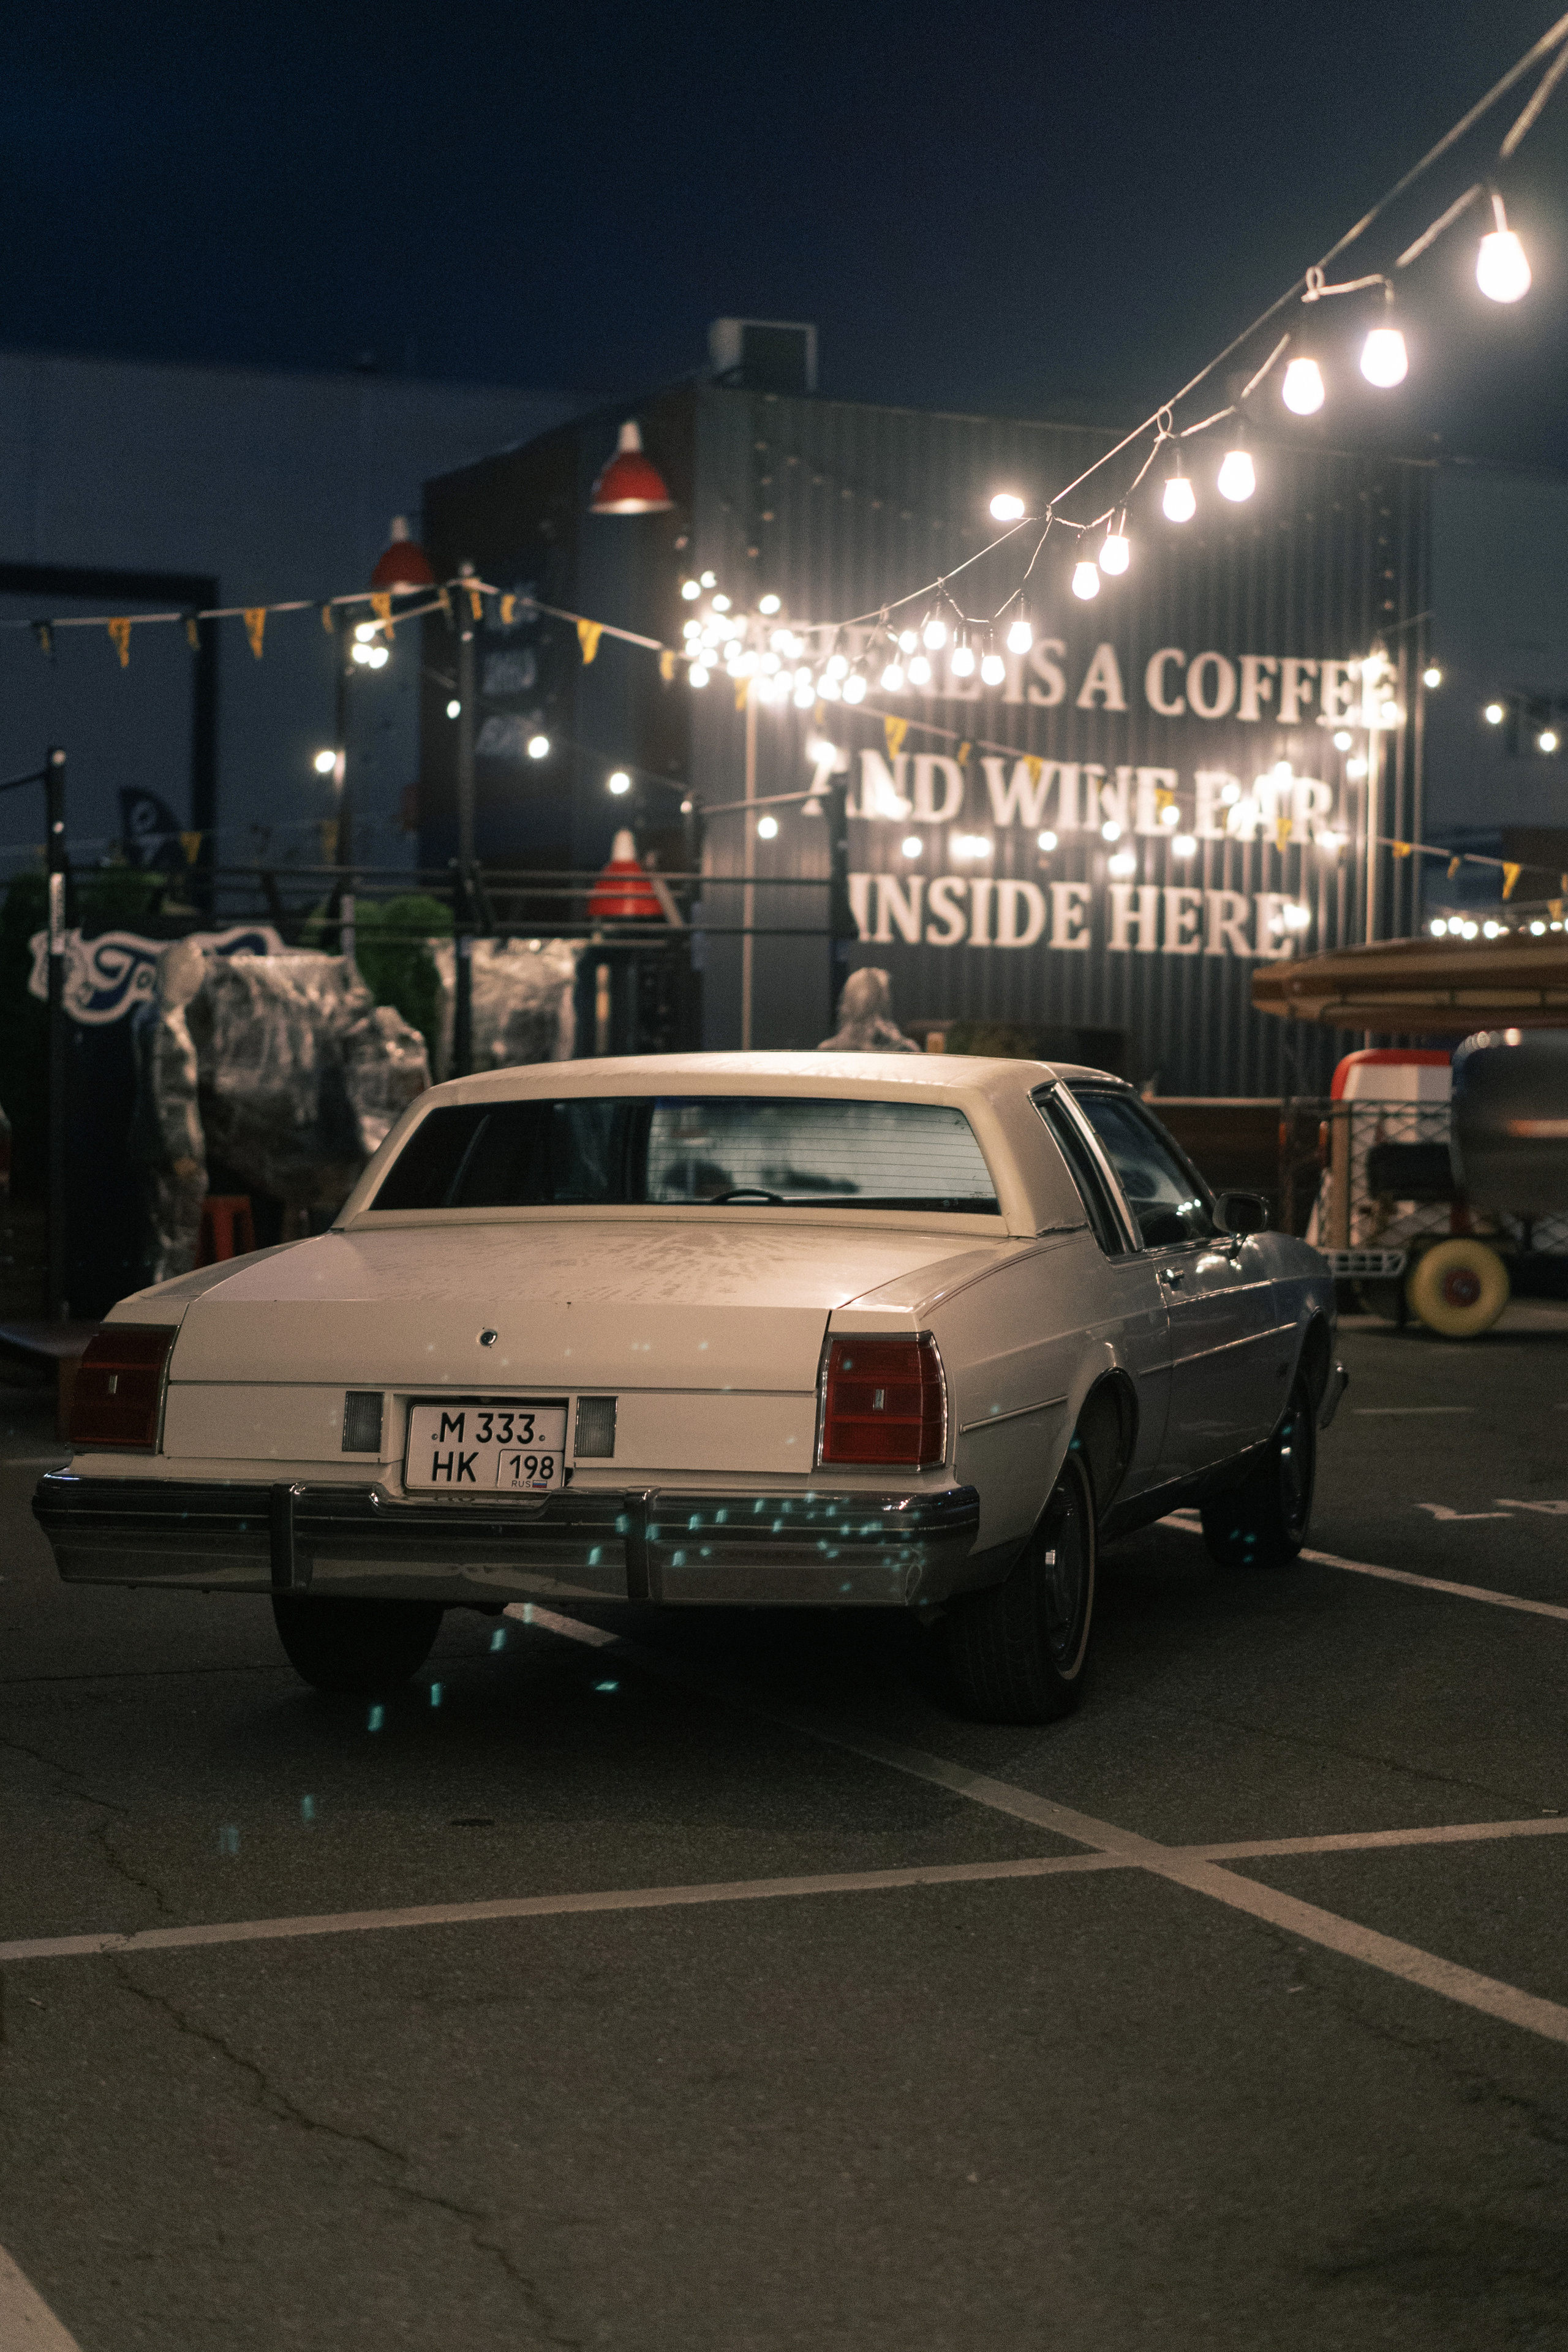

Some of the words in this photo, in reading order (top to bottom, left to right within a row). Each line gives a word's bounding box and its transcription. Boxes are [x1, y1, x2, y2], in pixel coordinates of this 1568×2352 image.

[1001, 638, 1068, 707] IS
[1076, 643, 1128, 711] A
[1145, 648, 1407, 729] COFFEE
[981, 757, 1179, 836] WINE
[848, 872, 1092, 950] INSIDE
[1107, 883, 1297, 960] HERE
[431, 1451, 480, 1483] HK
[508, 1455, 554, 1480] 198
[439, 1412, 466, 1443] M
[475, 1412, 536, 1444] 333
